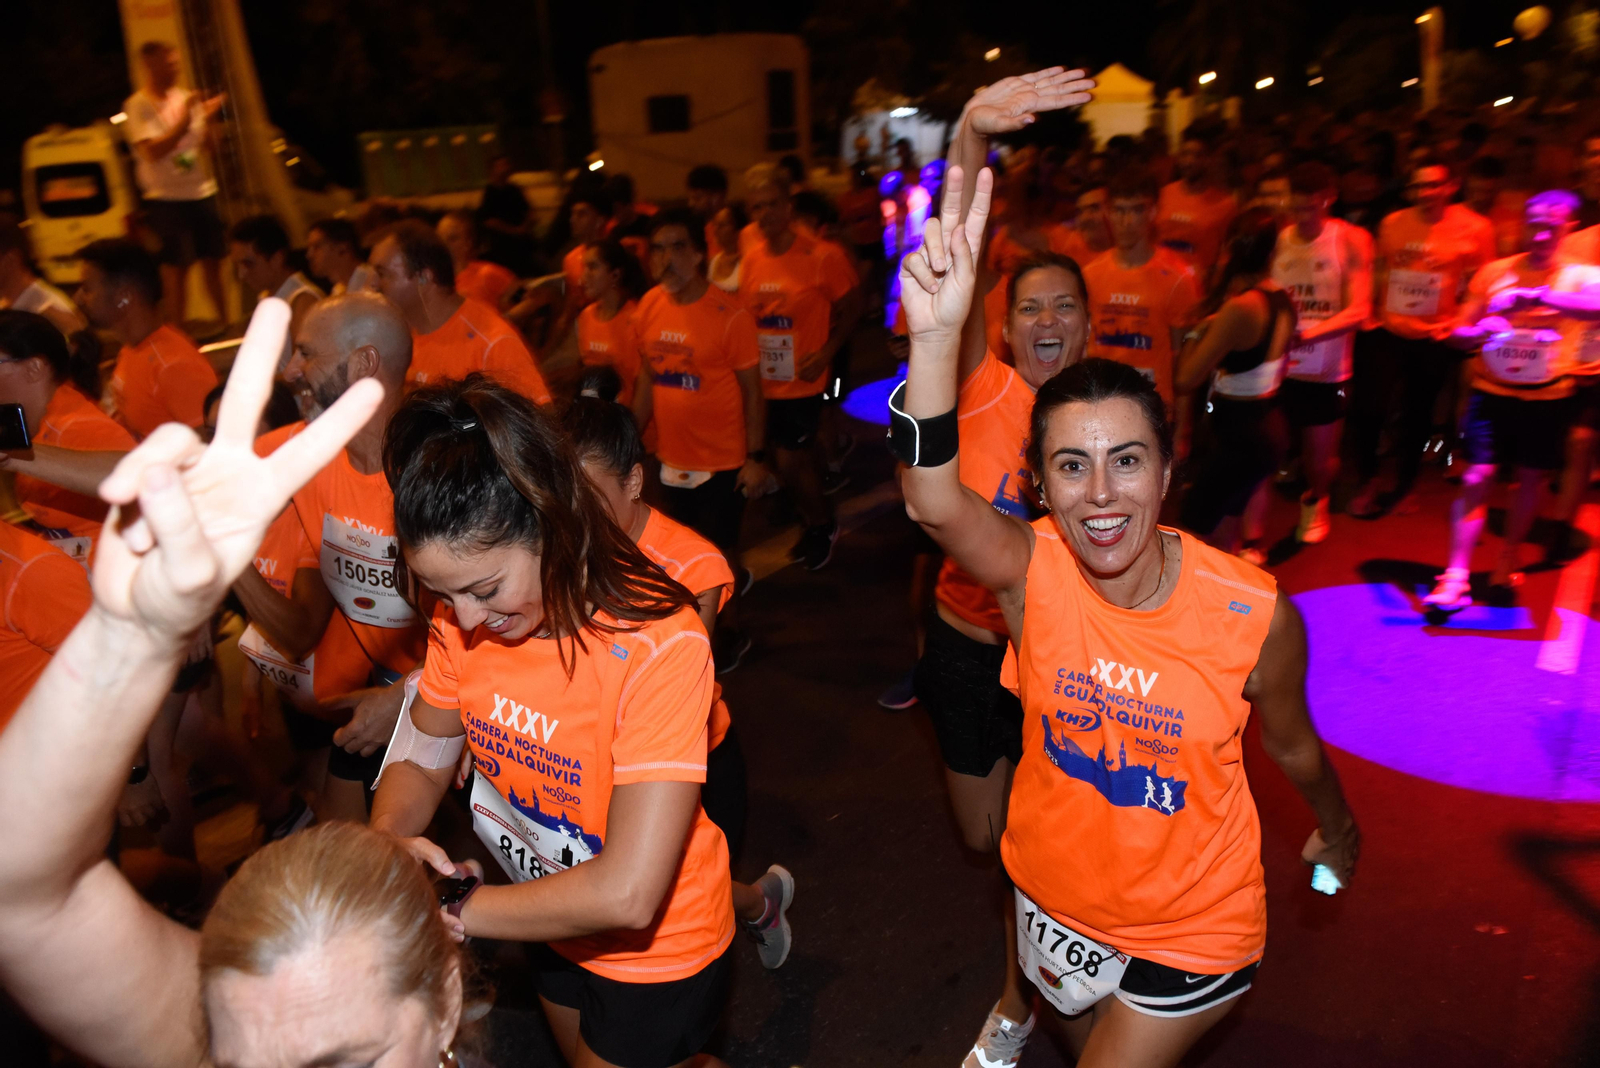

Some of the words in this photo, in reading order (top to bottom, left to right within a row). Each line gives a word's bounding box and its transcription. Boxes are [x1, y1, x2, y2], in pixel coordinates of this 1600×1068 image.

[1109, 292, 1140, 306] XXXV
[660, 330, 687, 344] XXXV
[334, 556, 395, 589] 15058
[489, 693, 559, 744] XXXV
[1053, 680, 1063, 695] DEL
[1063, 684, 1183, 738] GUADLQUIVIR
[1105, 692, 1185, 721] NOCTURNA
[466, 711, 510, 743] CARRERA
[515, 736, 583, 771] NOCTURNA
[469, 730, 582, 787] GUADALQUIVIR
[499, 834, 553, 879] 818
[1025, 911, 1103, 978] 11768
[1072, 974, 1097, 996] PEDROSA
